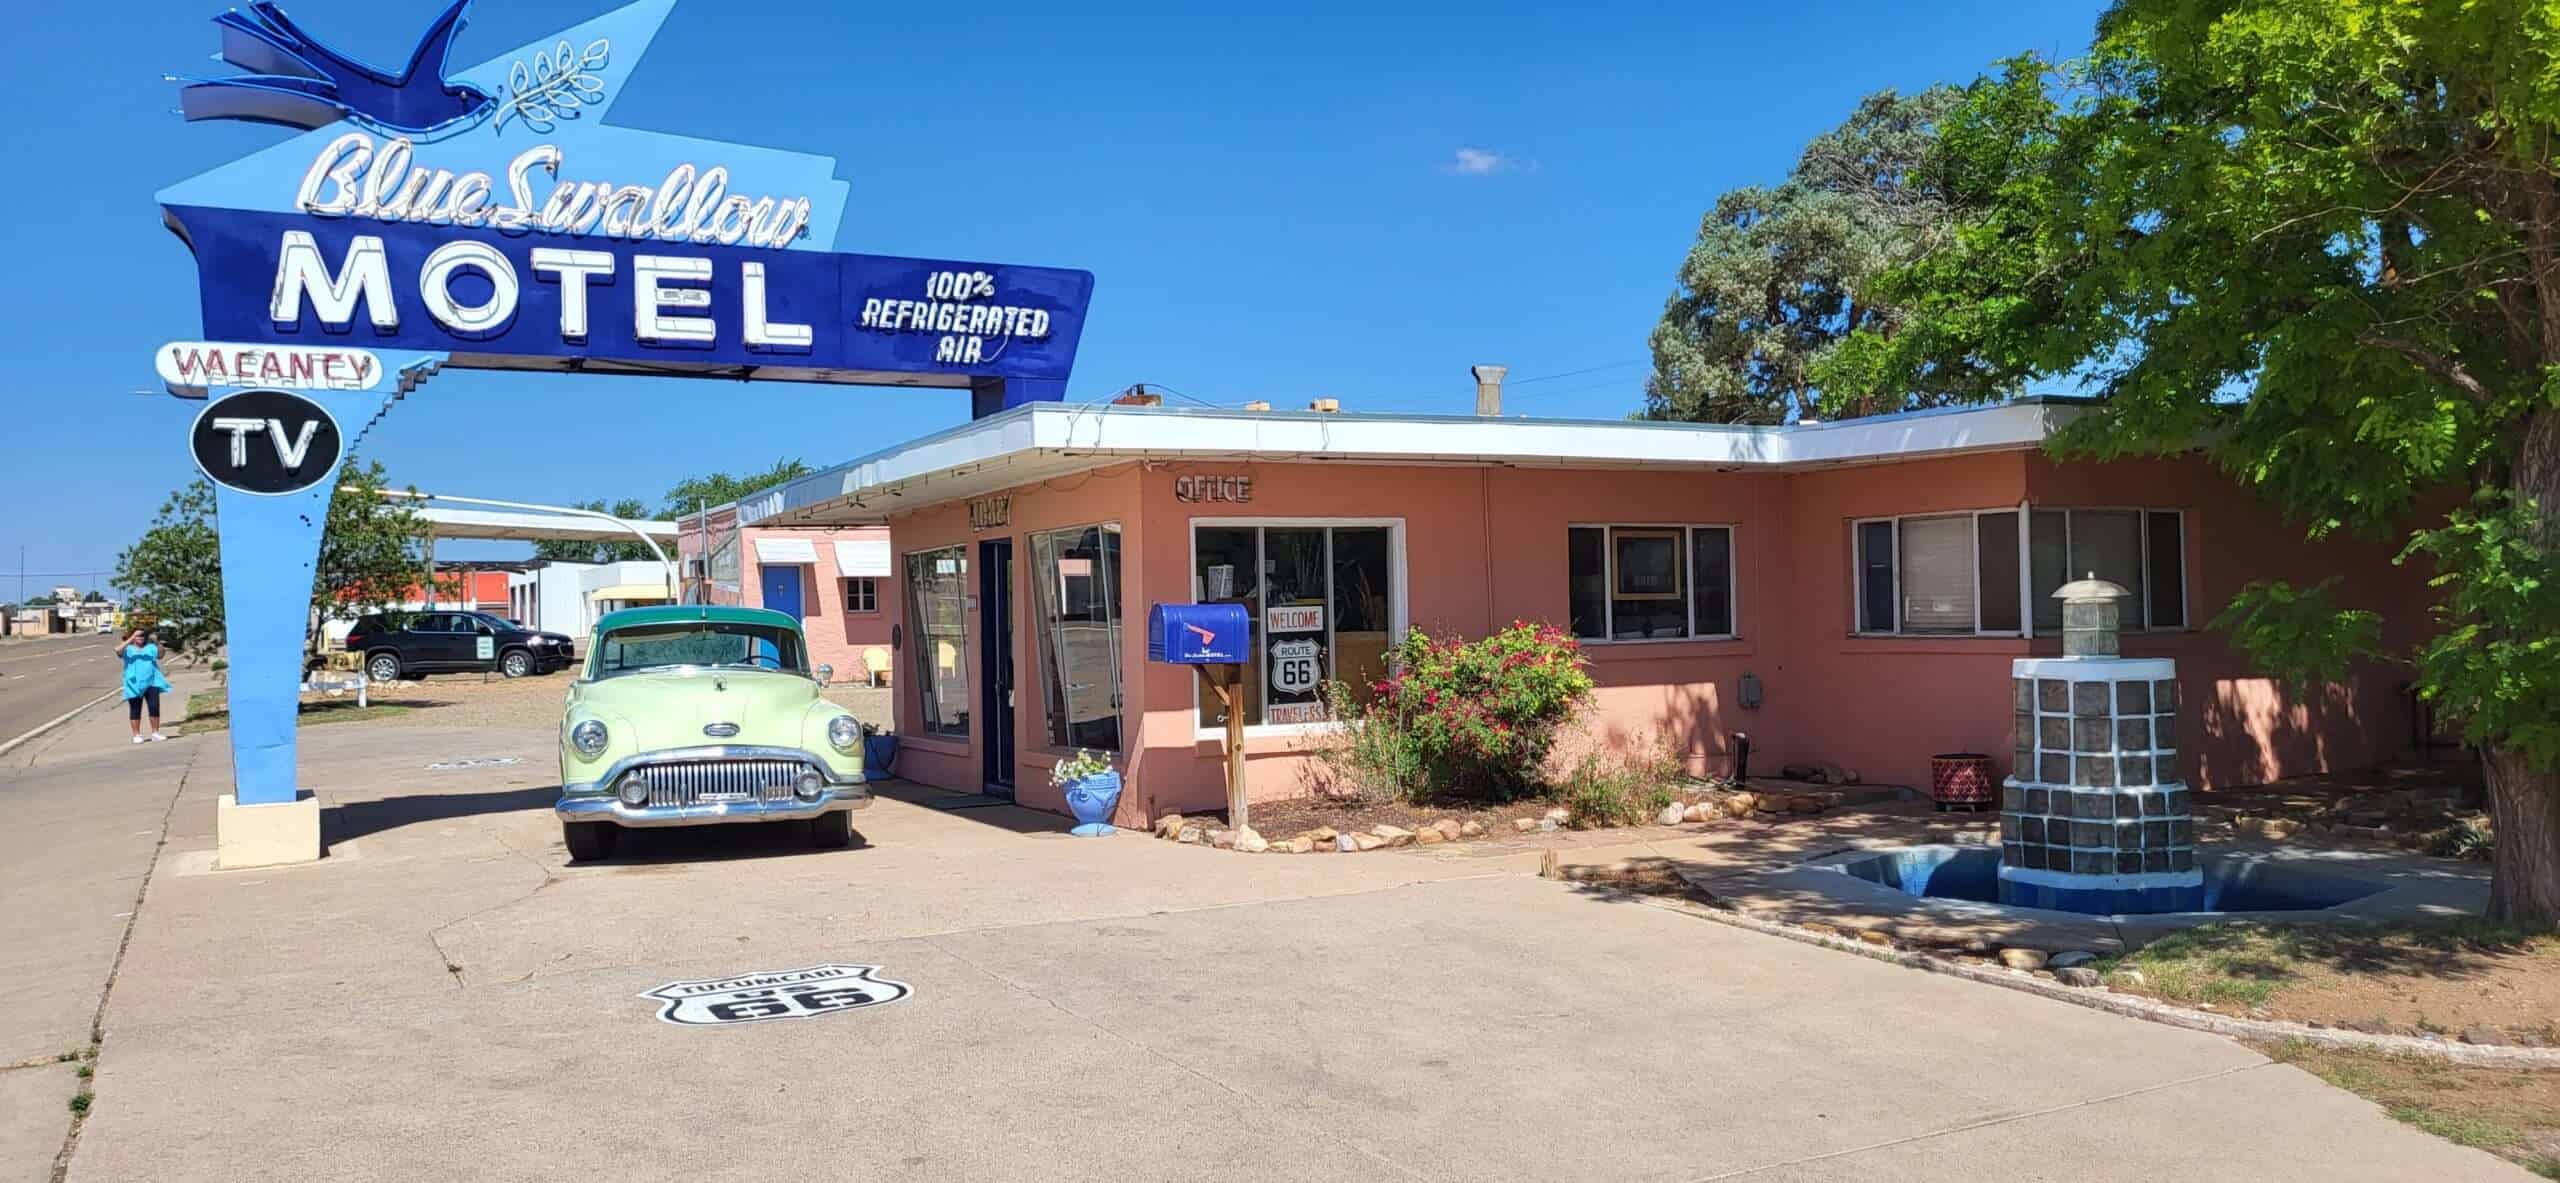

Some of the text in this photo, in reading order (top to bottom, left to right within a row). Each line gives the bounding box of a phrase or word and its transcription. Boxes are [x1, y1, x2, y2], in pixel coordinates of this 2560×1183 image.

[296, 132, 811, 249] Blue Swallow
[270, 230, 813, 347] MOTEL
[926, 271, 995, 300] 100%
[861, 297, 1050, 338] REFRIGERATED
[936, 334, 983, 364] AIR
[171, 347, 372, 386] VACANCY
[211, 416, 320, 469] TV
[1176, 474, 1251, 503] OFFICE
[1270, 610, 1320, 630] WELCOME
[1281, 646, 1312, 657] ROUTE
[1283, 659, 1311, 685] 66
[680, 967, 845, 995] TUCUMCARI
[732, 985, 819, 999] US
[706, 987, 875, 1021] 66
